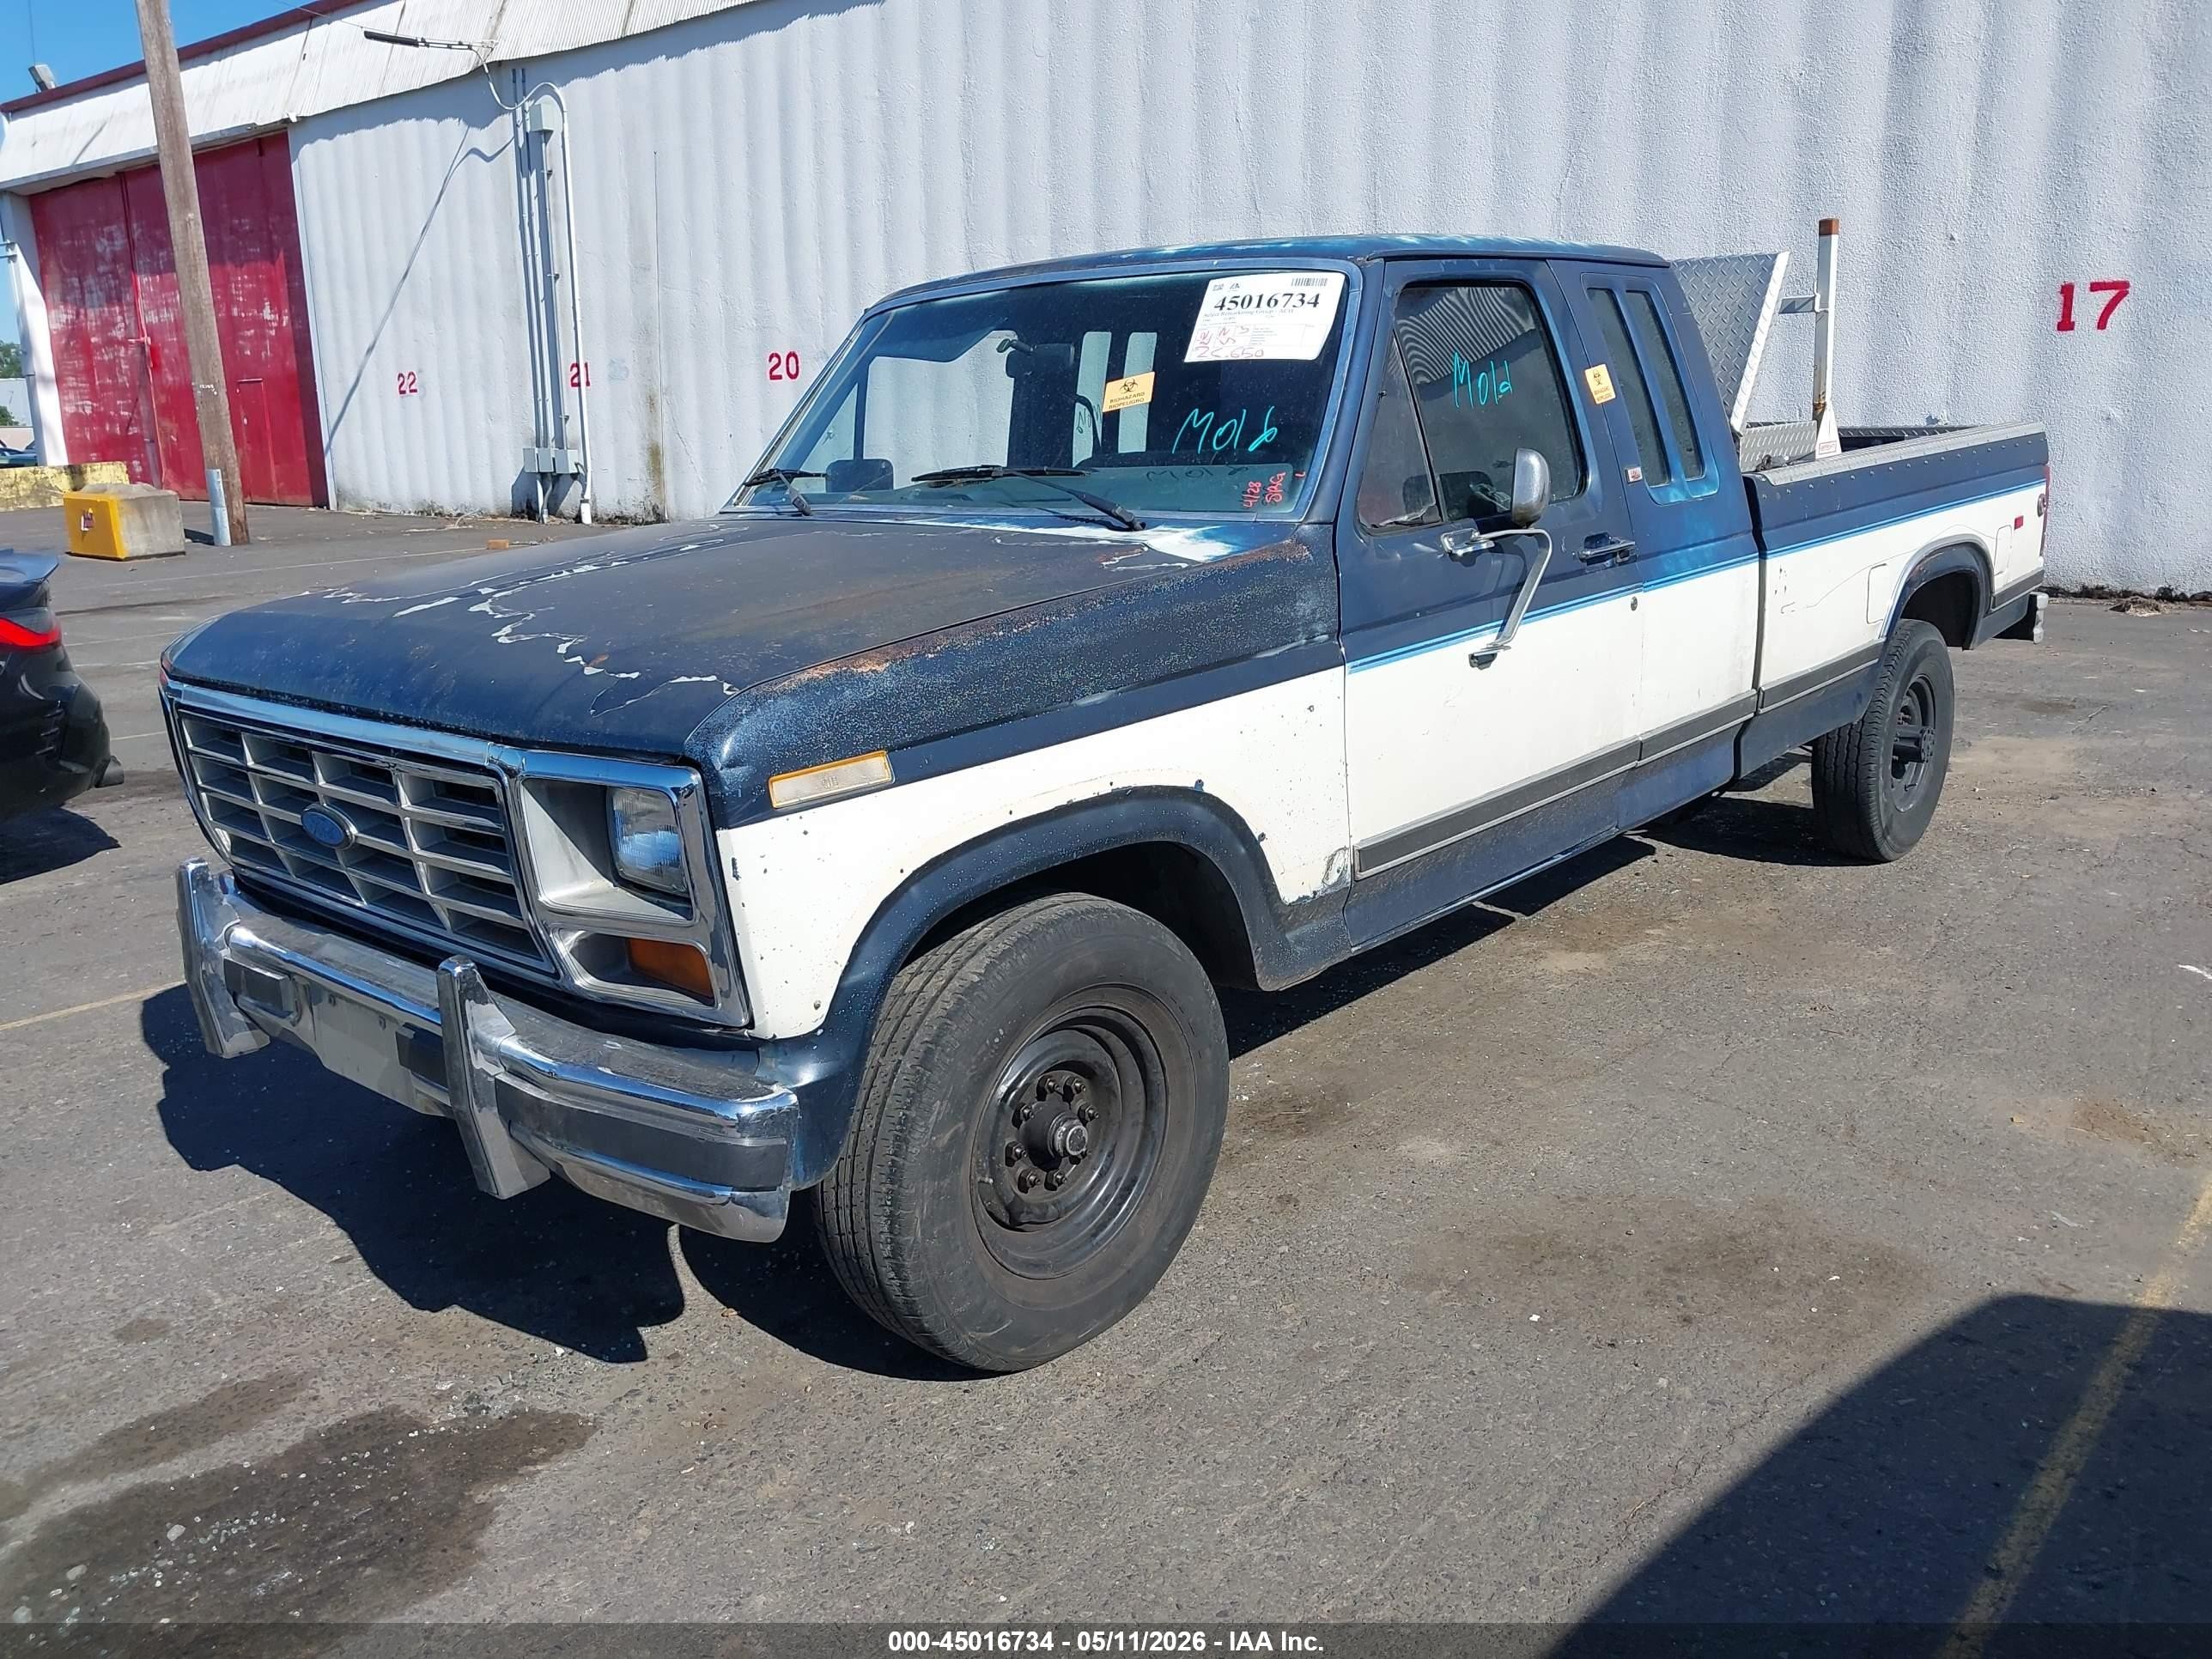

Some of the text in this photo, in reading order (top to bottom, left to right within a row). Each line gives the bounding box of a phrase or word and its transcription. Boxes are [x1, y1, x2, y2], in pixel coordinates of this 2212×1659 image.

[1214, 293, 1320, 311] 45016734
[2057, 281, 2130, 331] 17
[570, 362, 590, 387] 21
[769, 351, 799, 380] 20
[398, 372, 417, 394] 22
[1452, 351, 1513, 408] Mold
[1109, 398, 1145, 410] BIOPELIGRO
[1110, 392, 1146, 404] BIOHAZARD
